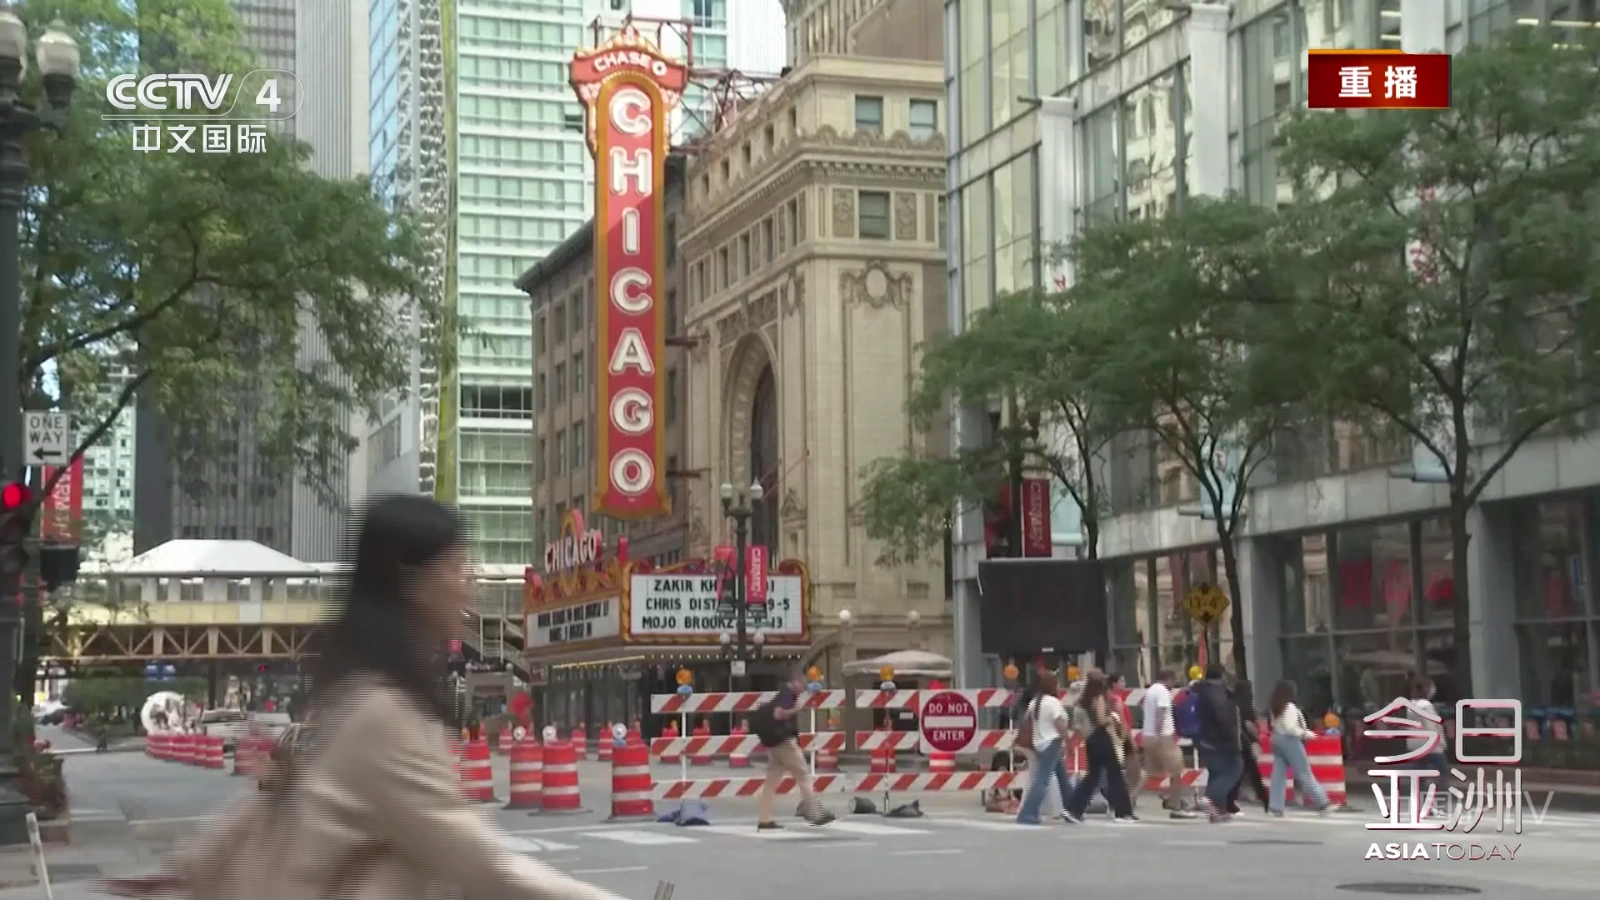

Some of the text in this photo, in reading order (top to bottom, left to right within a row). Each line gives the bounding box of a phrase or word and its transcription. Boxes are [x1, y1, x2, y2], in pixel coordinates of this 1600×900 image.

[594, 51, 651, 72] CHASE
[608, 88, 655, 497] CHICAGO
[30, 417, 63, 429] ONE
[30, 431, 64, 444] WAY
[545, 528, 597, 573] CHICAGO
[654, 579, 693, 592] ZAKIR
[701, 579, 718, 592] KH
[645, 598, 682, 611] CHRIS
[689, 598, 718, 611] DIST
[642, 616, 676, 629] MOJO
[928, 702, 969, 714] DO NOT
[933, 729, 966, 741] ENTER
